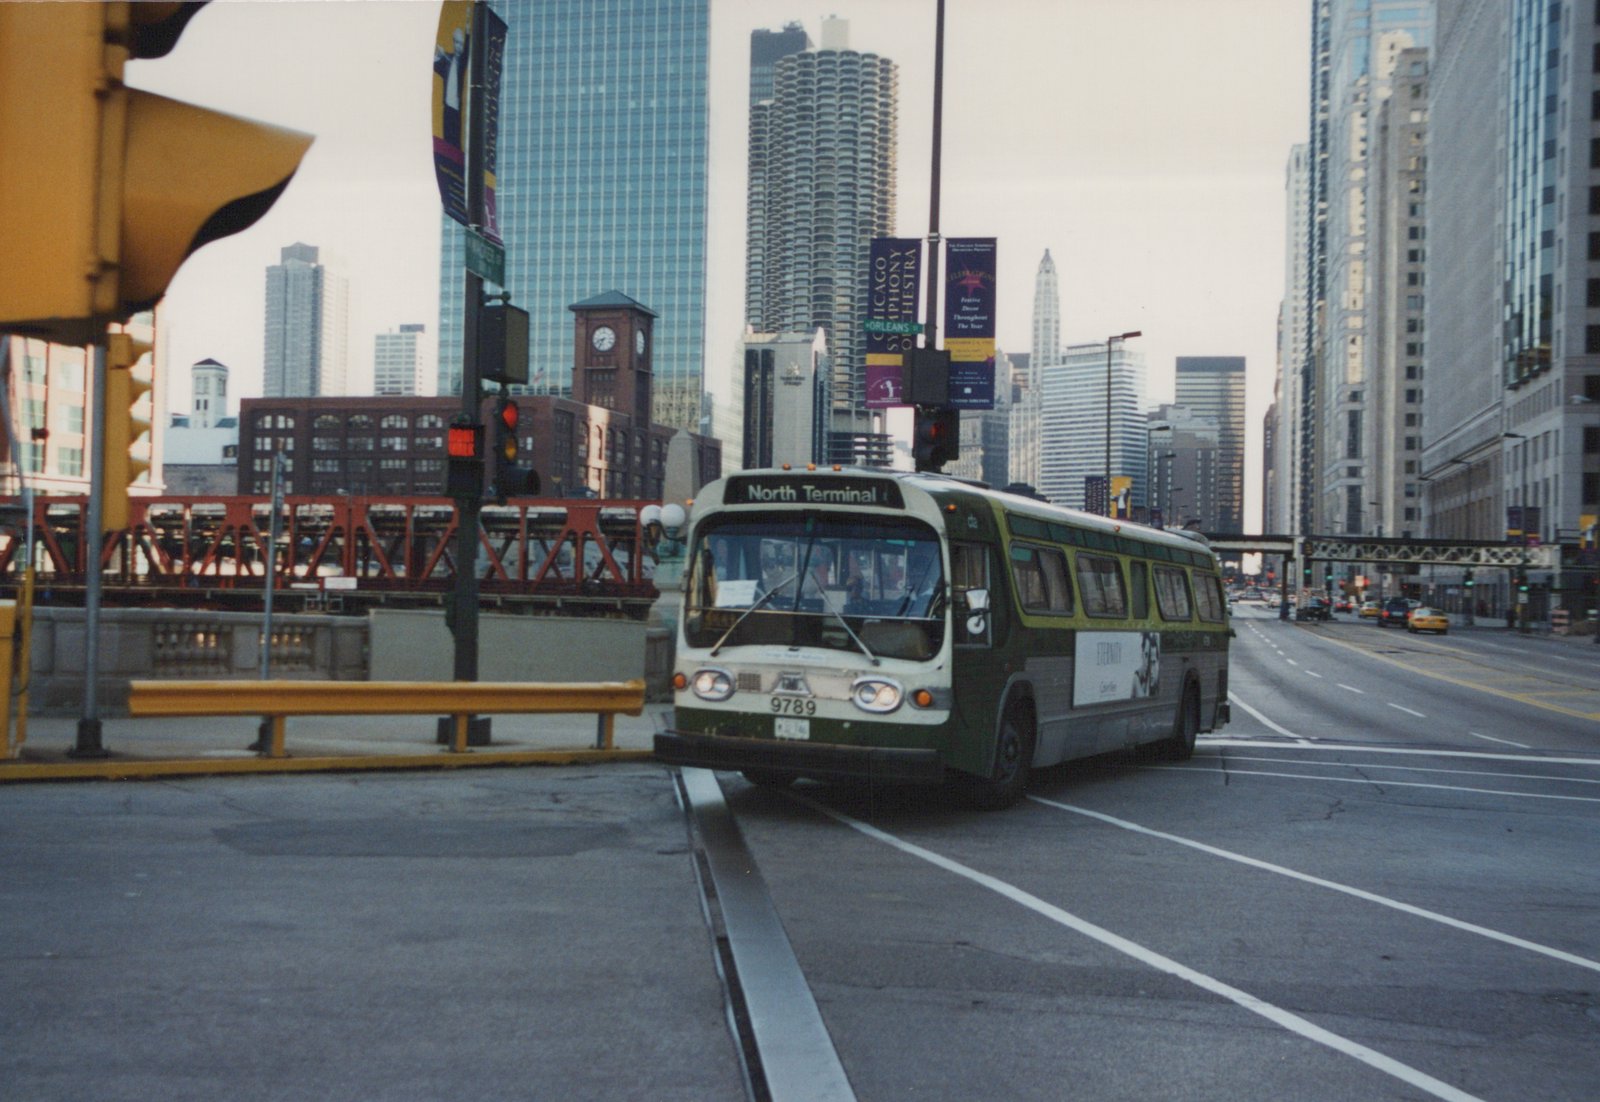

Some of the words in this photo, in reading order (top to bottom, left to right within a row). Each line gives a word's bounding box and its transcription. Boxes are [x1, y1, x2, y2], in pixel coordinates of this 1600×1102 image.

[870, 321, 909, 332] ORLEANS
[748, 484, 796, 501] North
[803, 485, 877, 503] Terminal
[771, 696, 817, 716] 9789
